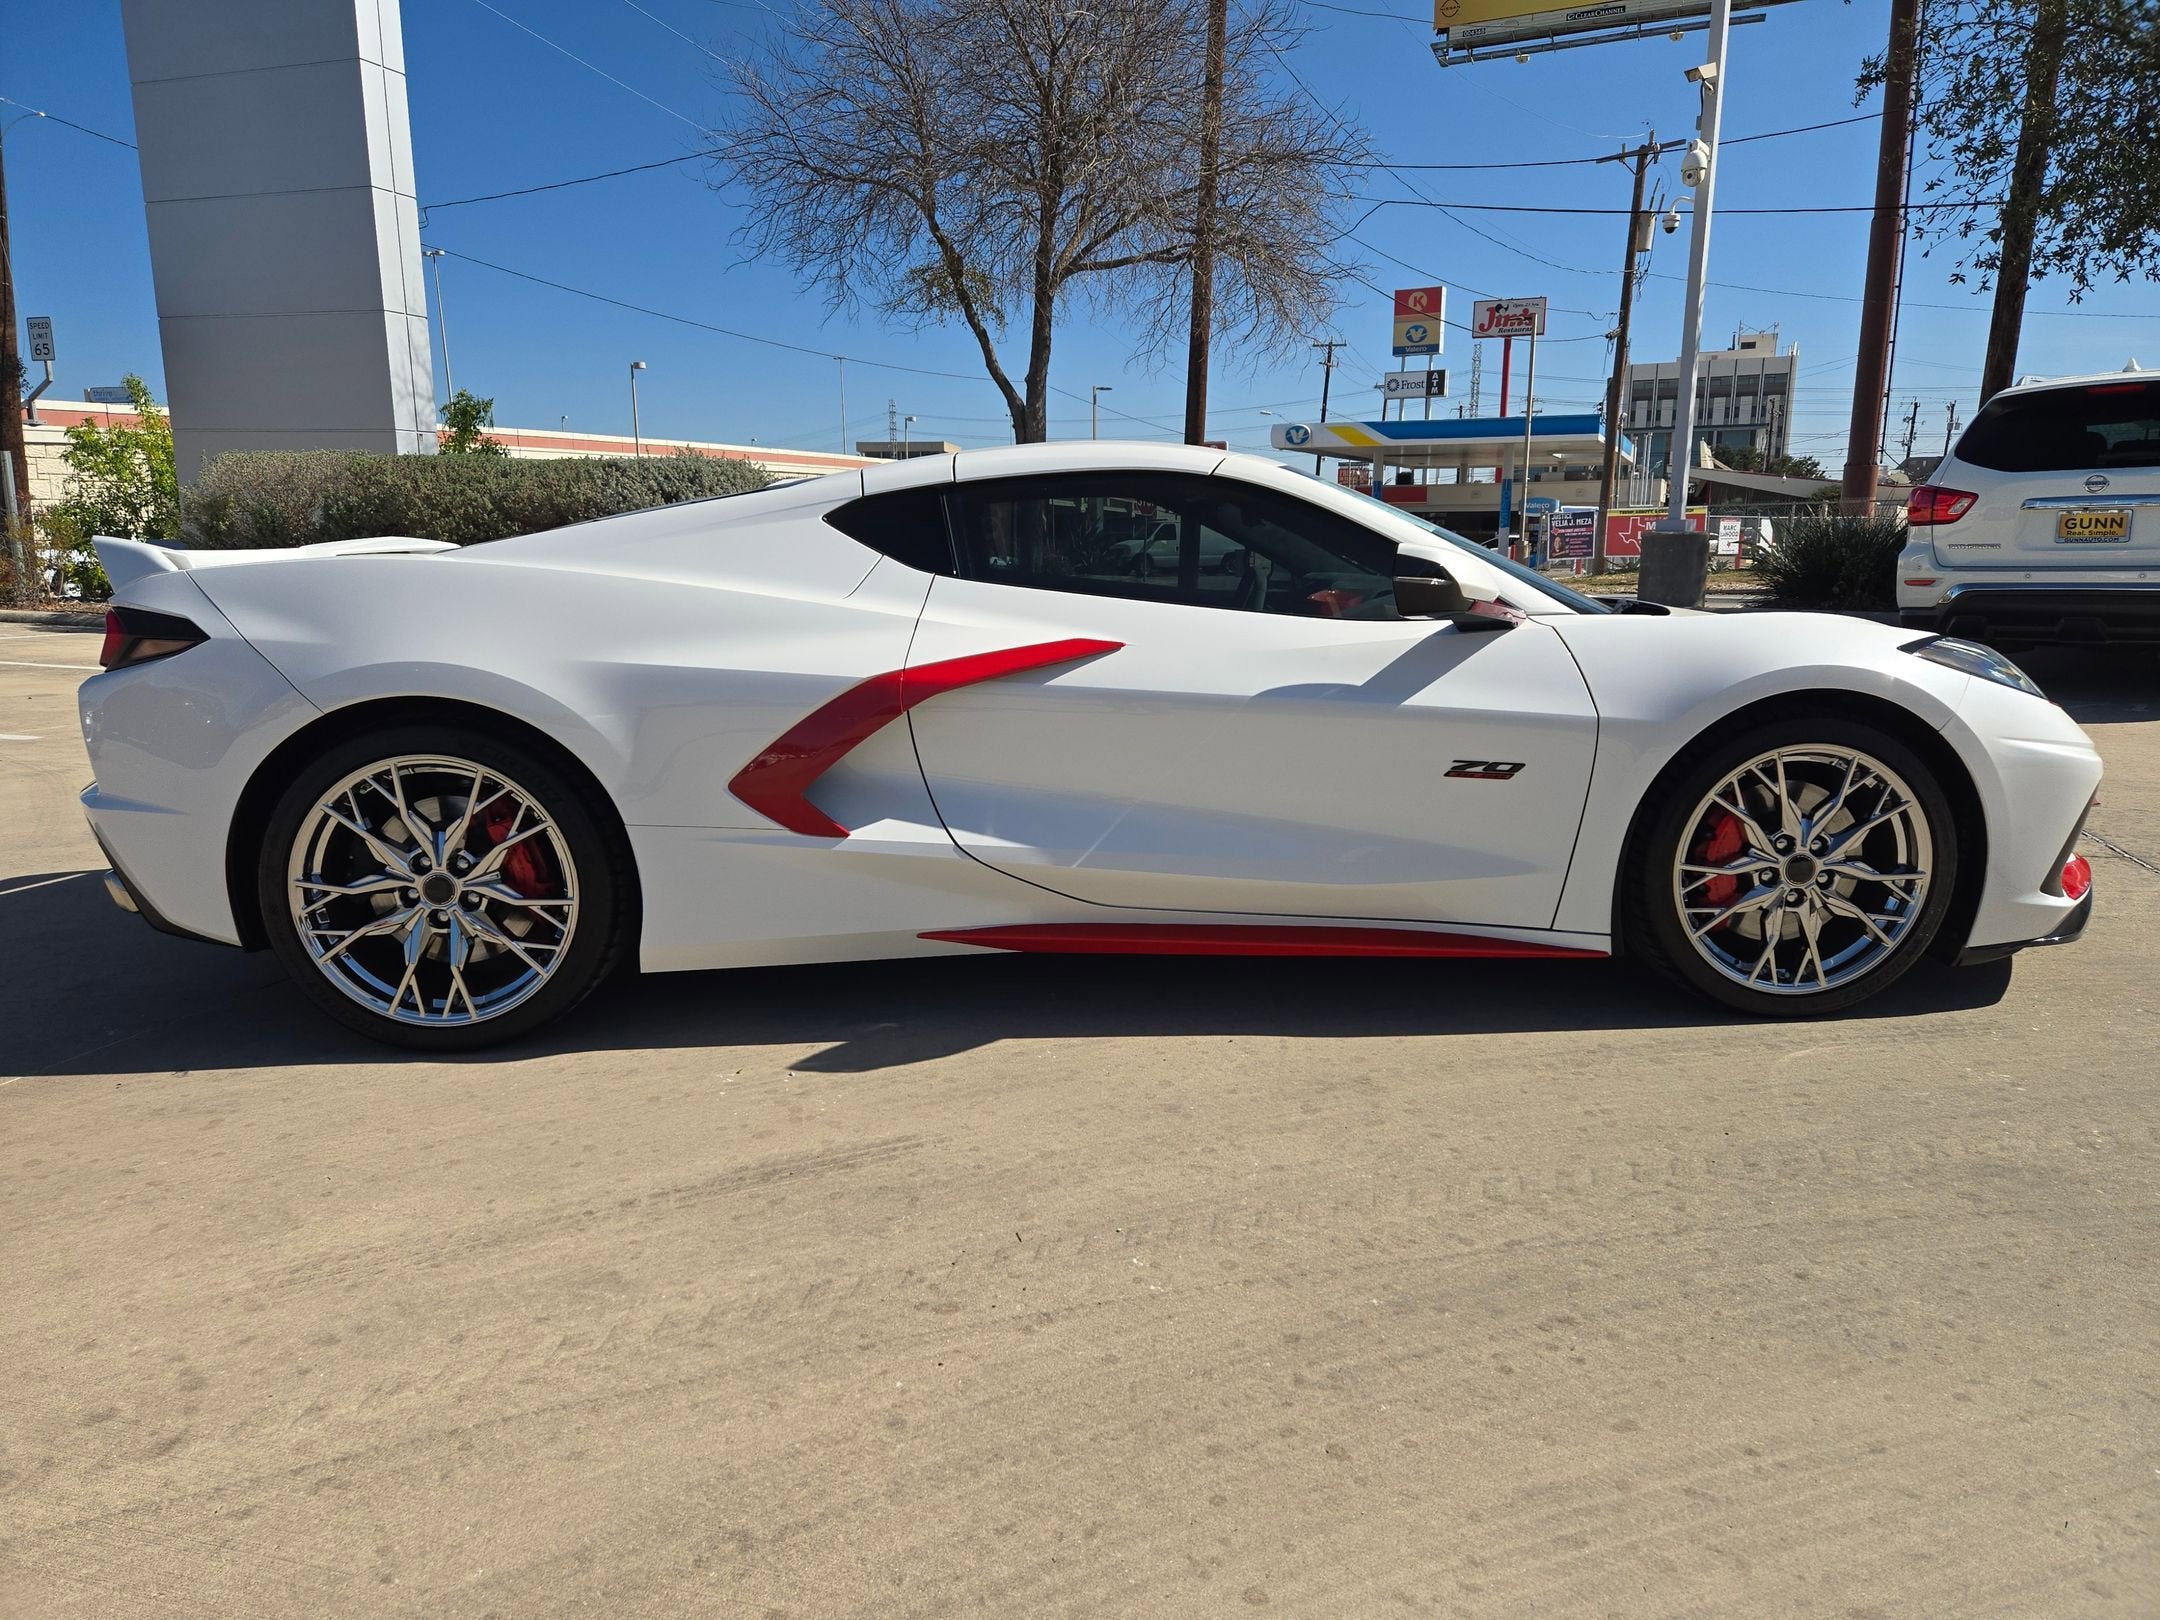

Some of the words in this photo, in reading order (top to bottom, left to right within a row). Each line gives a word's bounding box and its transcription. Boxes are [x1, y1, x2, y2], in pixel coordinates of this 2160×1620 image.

[1413, 295, 1425, 308] K
[1478, 306, 1533, 332] Jim's
[29, 321, 49, 330] SPEED
[32, 332, 48, 340] LIMIT
[34, 343, 51, 356] 65
[1401, 380, 1425, 390] Frost
[1431, 372, 1439, 394] ATM
[1576, 518, 1592, 526] MEZA
[2064, 517, 2125, 529] GUNN
